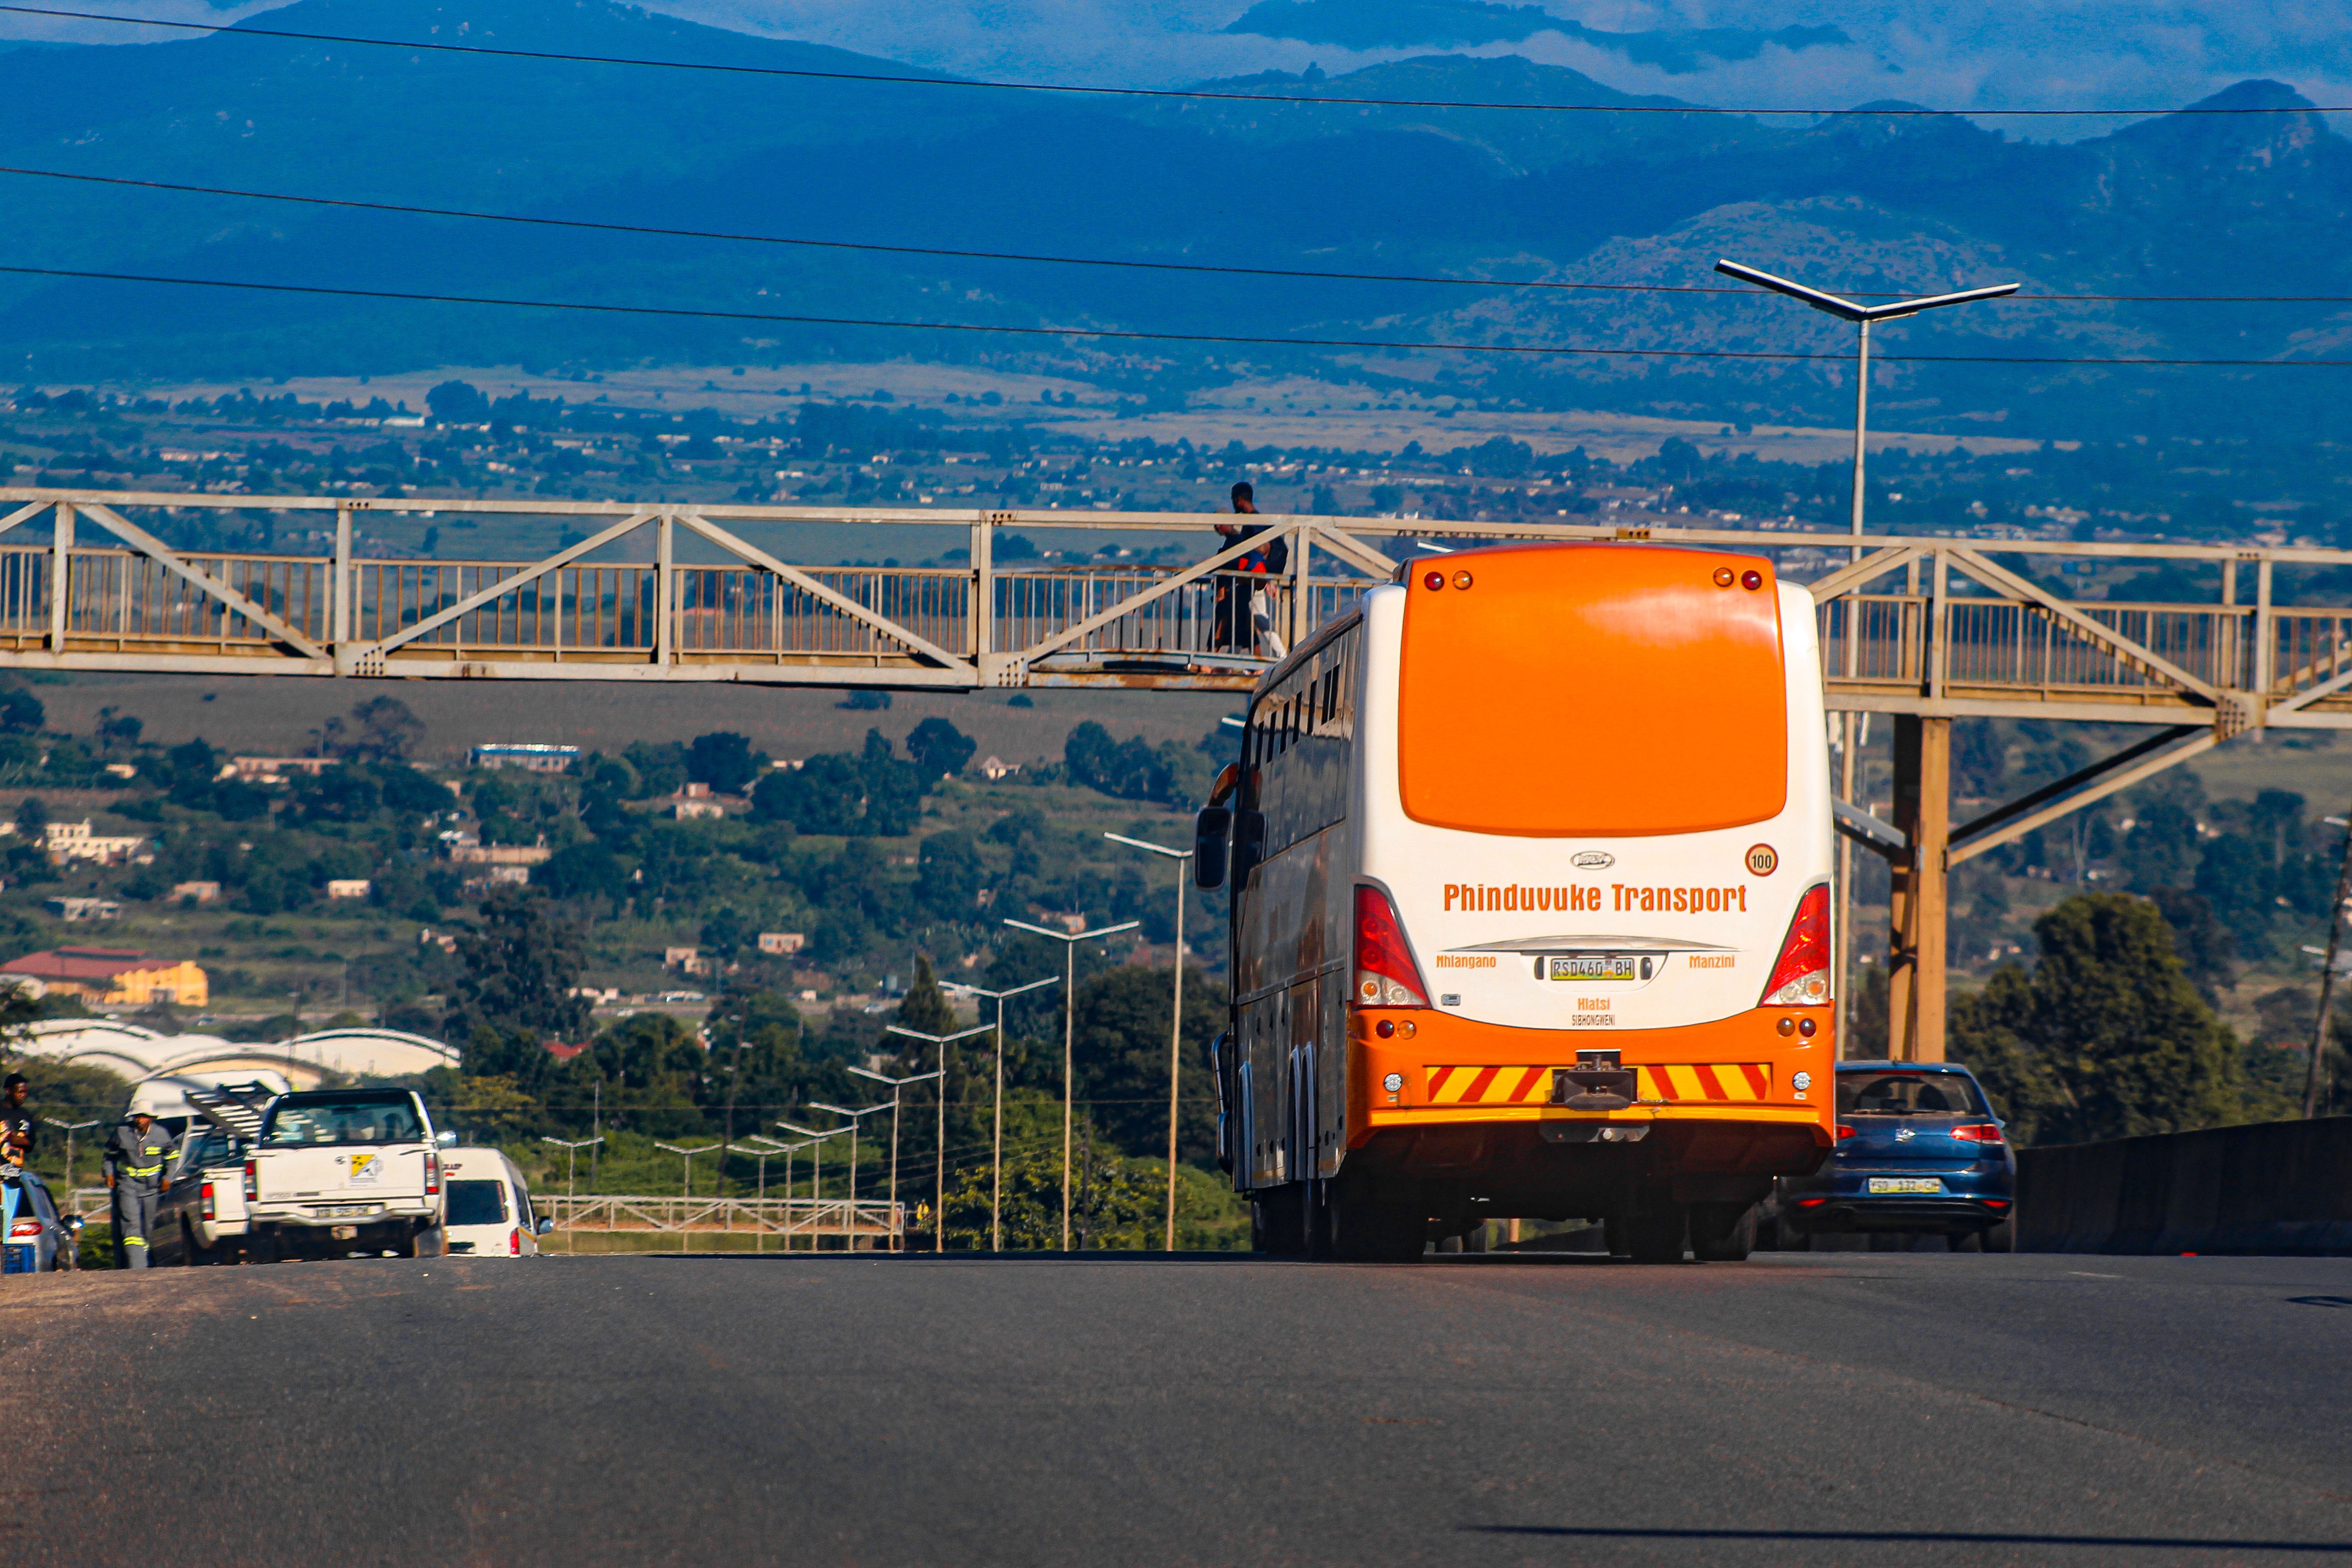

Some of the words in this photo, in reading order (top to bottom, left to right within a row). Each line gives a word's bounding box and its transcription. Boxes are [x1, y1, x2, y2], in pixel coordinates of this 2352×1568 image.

[1752, 855, 1771, 868] 100
[1444, 884, 1601, 911] Phinduvuke
[1612, 884, 1746, 914] Transport
[1689, 955, 1735, 968] Manzini
[1578, 998, 1610, 1010] Hlatsi
